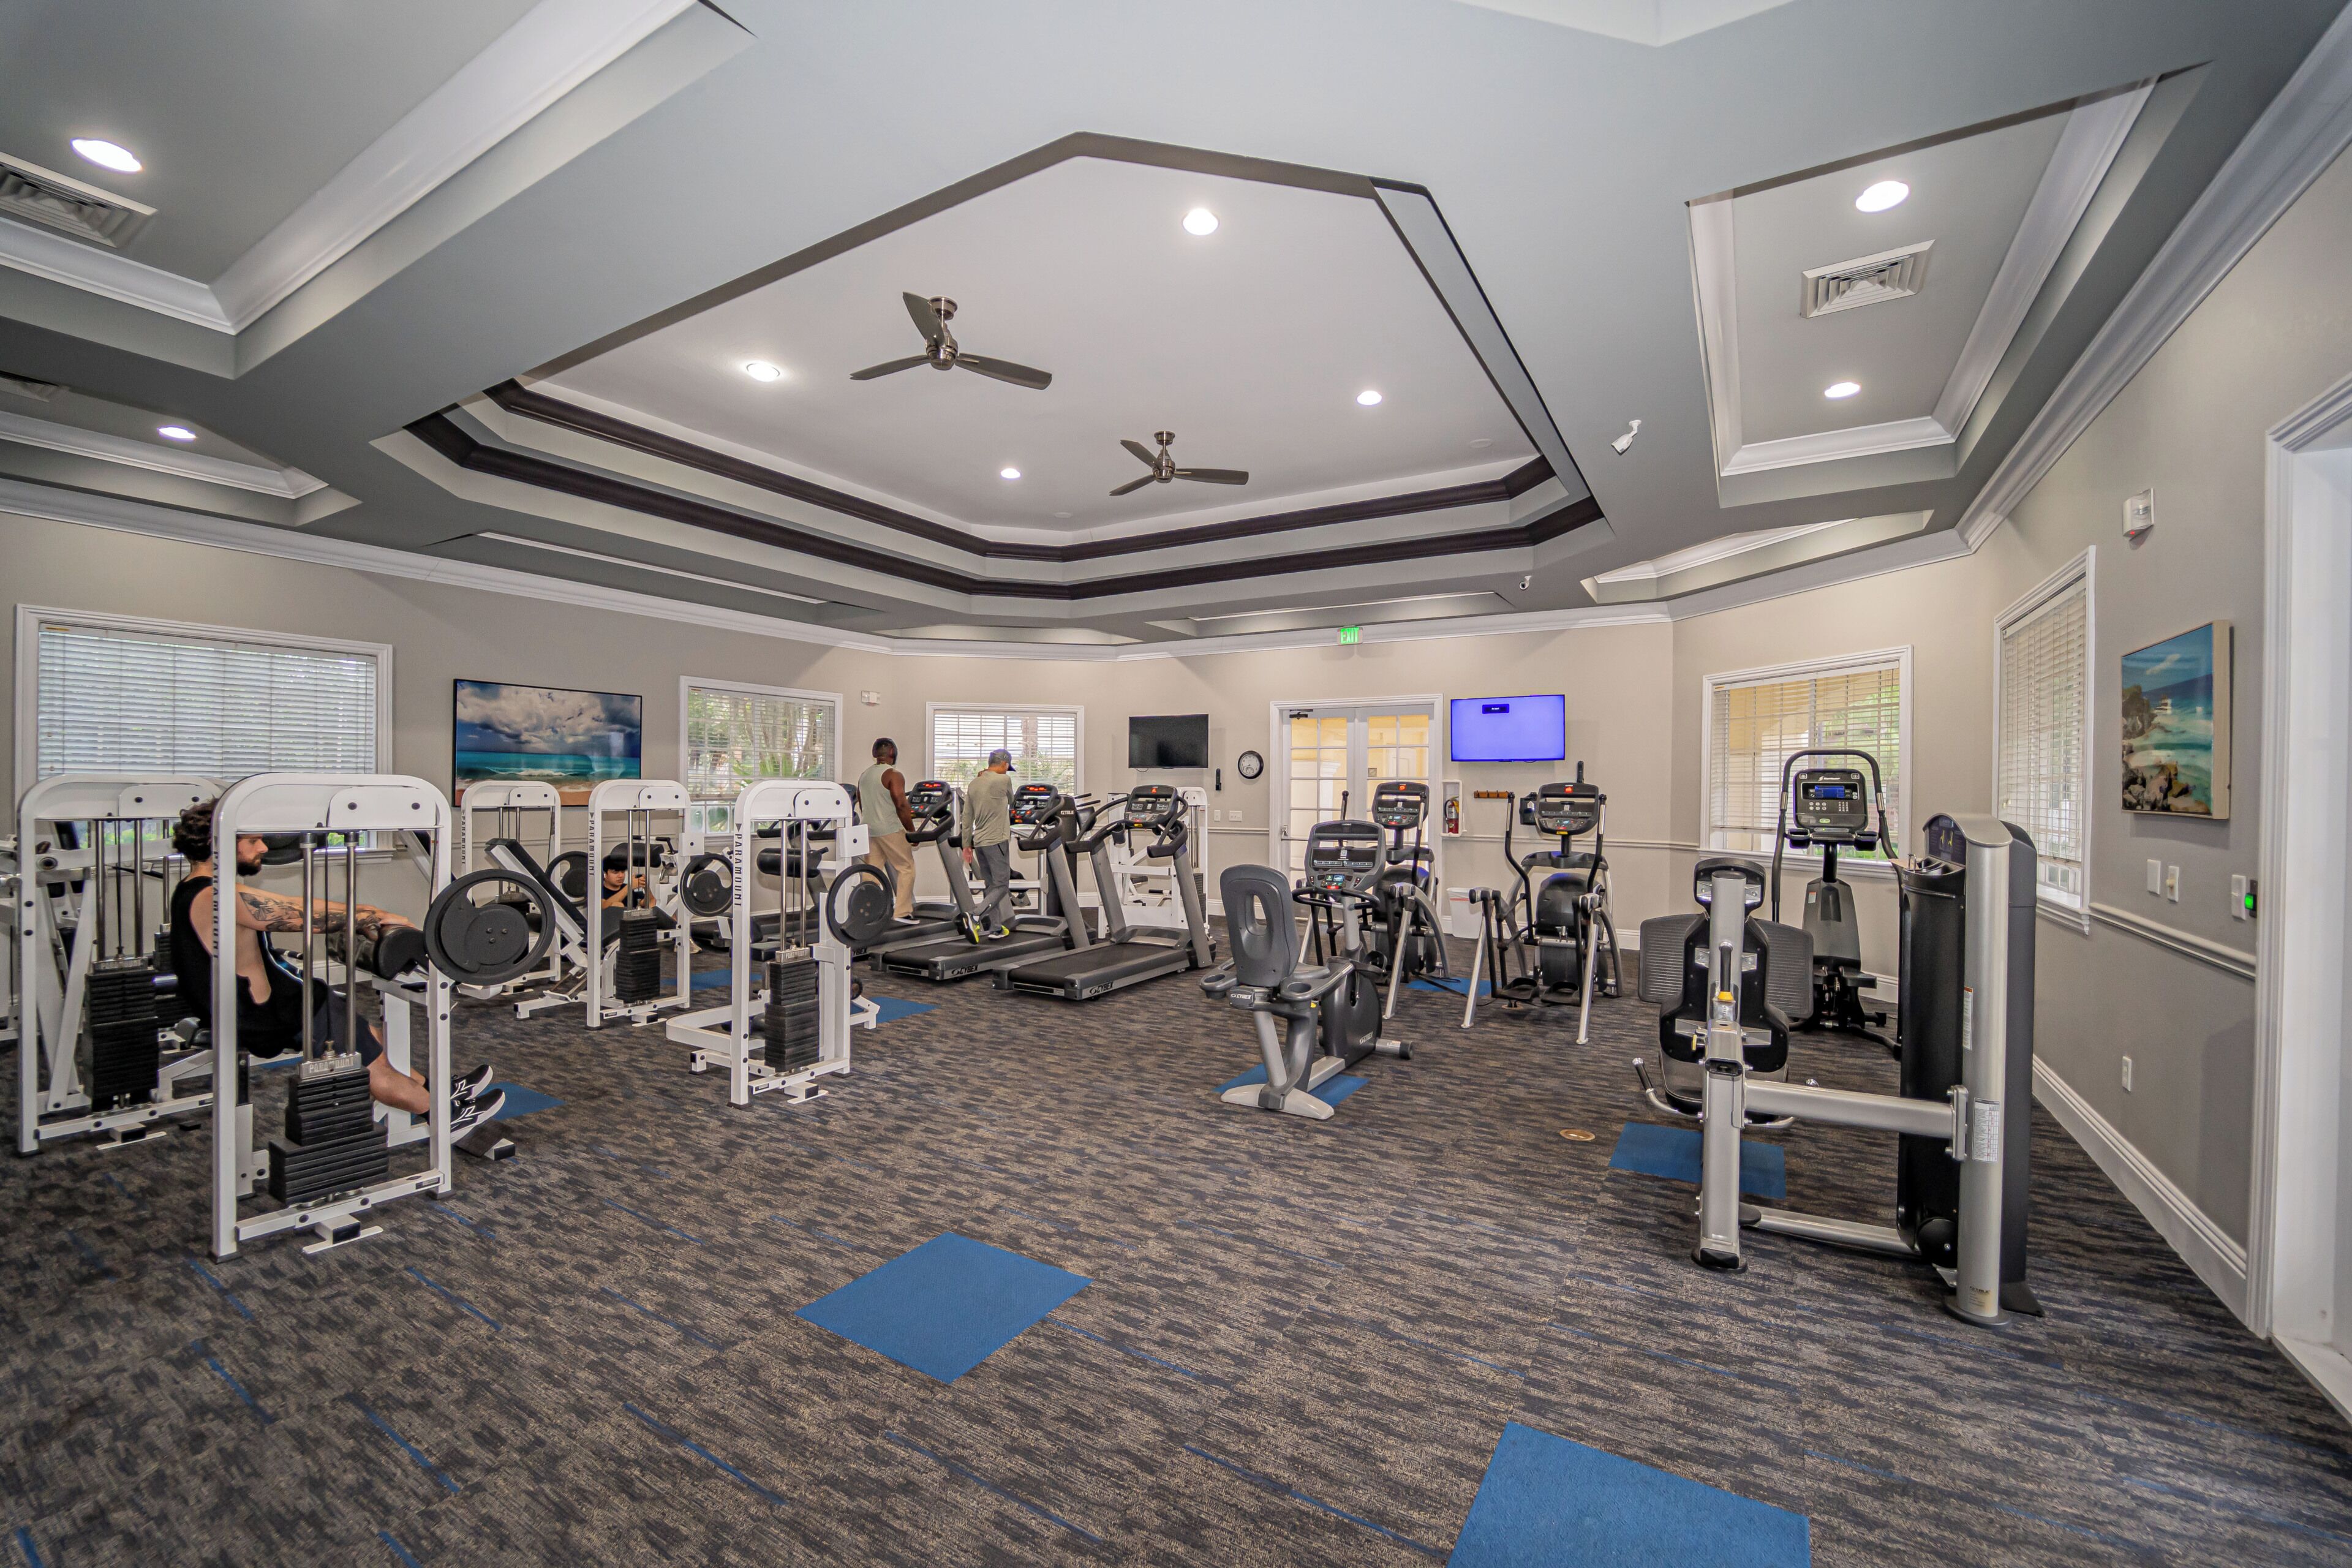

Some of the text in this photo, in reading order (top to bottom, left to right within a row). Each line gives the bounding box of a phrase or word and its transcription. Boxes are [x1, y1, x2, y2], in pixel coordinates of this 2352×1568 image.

[1340, 627, 1360, 644] EXIT
[734, 833, 742, 907] PARAMOUNT
[959, 965, 978, 974] CYBEX
[1096, 981, 1114, 993] CYBEX
